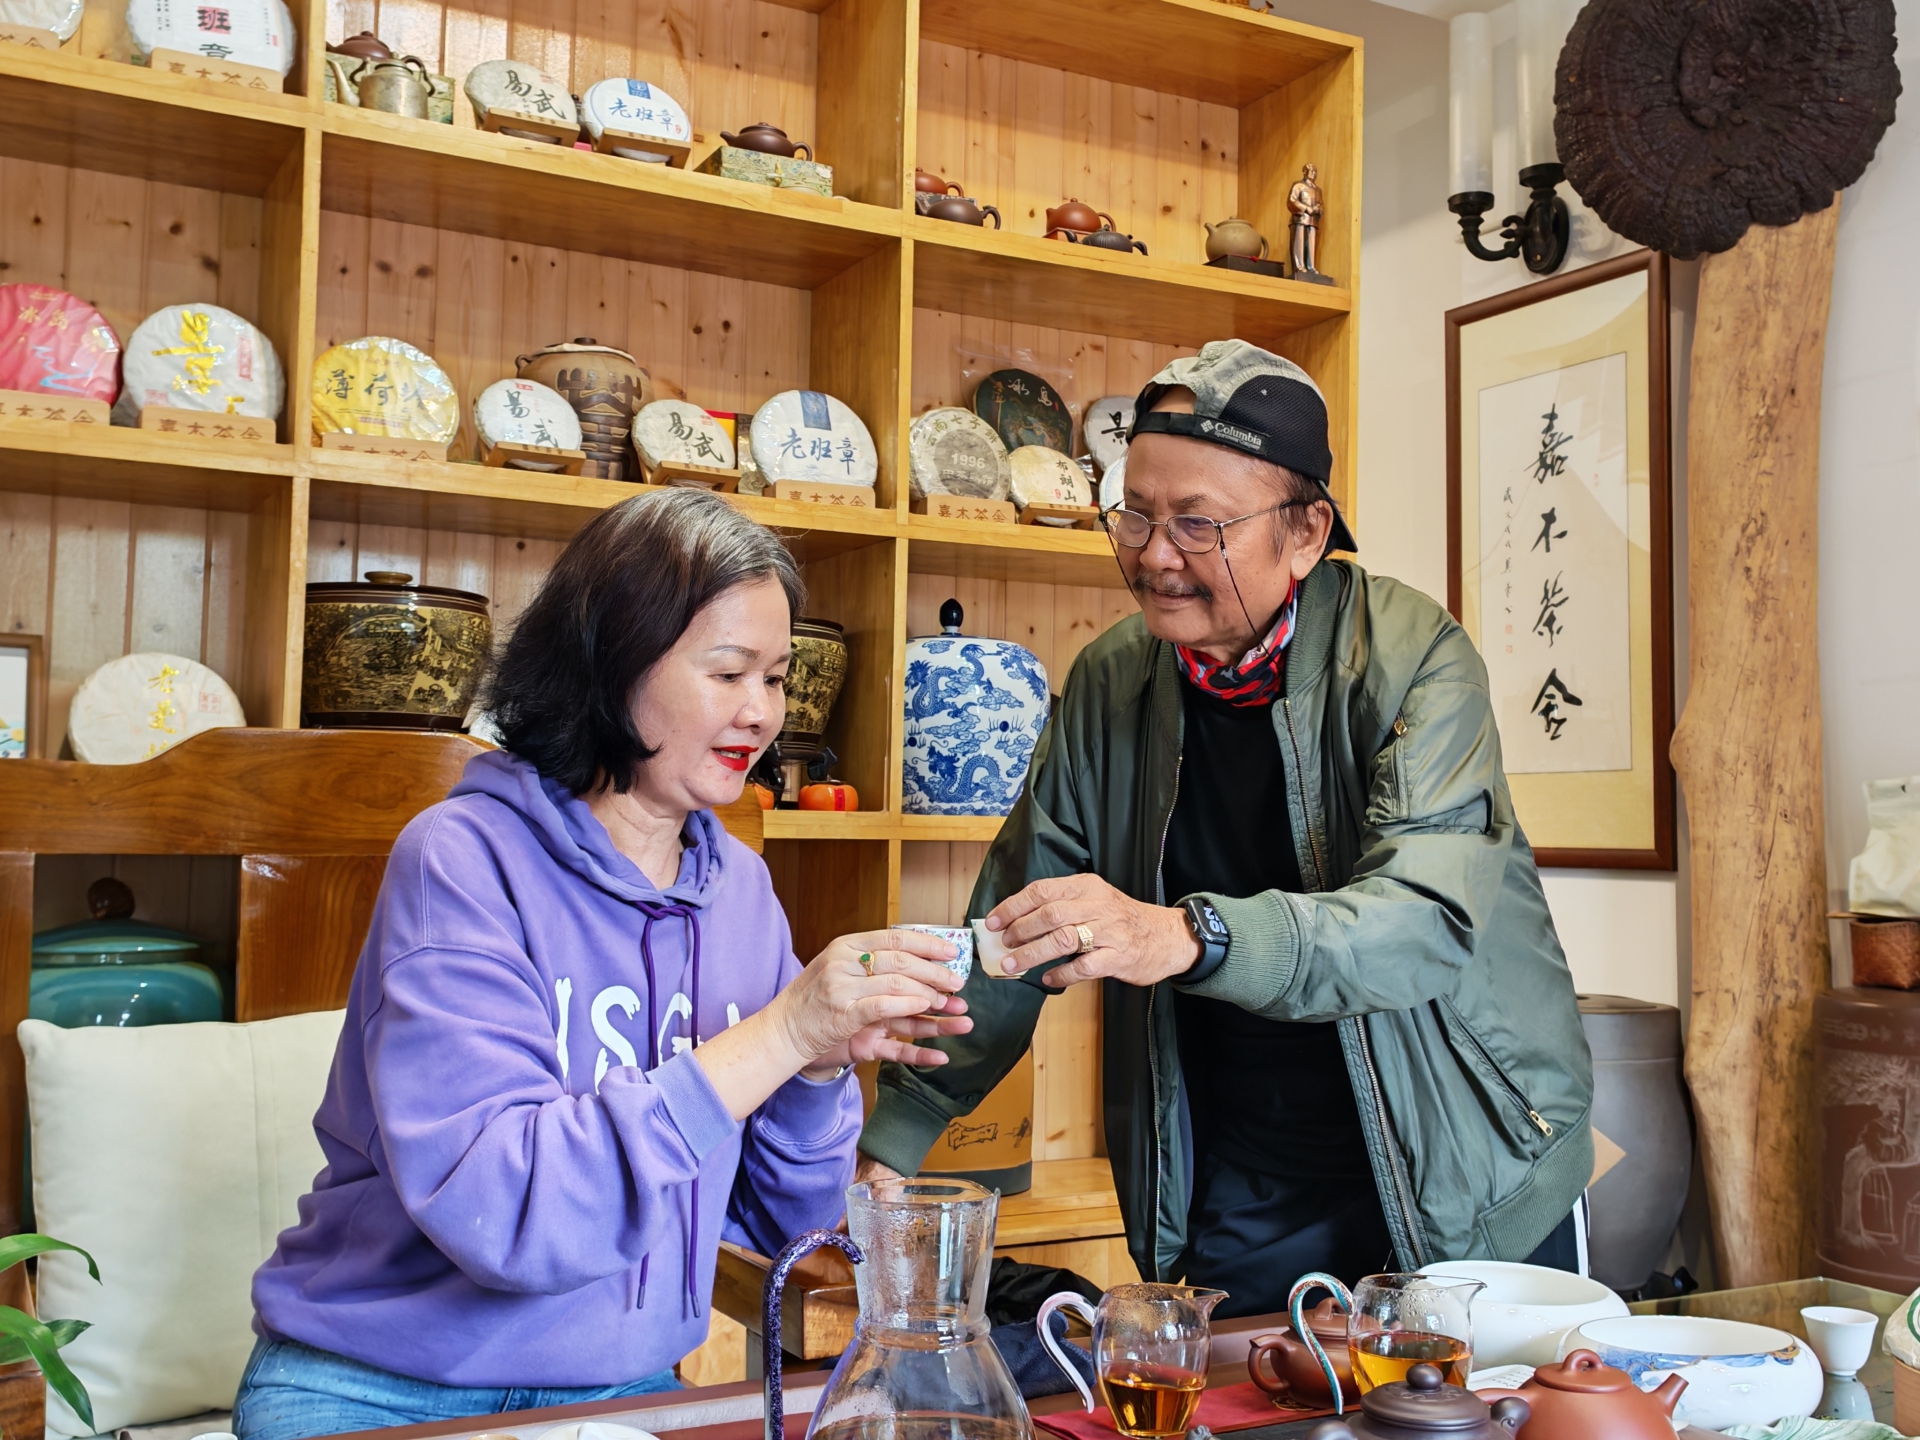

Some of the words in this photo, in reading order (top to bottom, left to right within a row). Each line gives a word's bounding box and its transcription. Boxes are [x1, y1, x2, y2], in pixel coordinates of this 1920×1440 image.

[608, 97, 676, 132] 老班章
[667, 411, 725, 464] 易武
[780, 426, 857, 476] 老班章
[1214, 422, 1262, 447] Columbia
[951, 452, 986, 469] 1996
[1055, 460, 1078, 503] 布朗山
